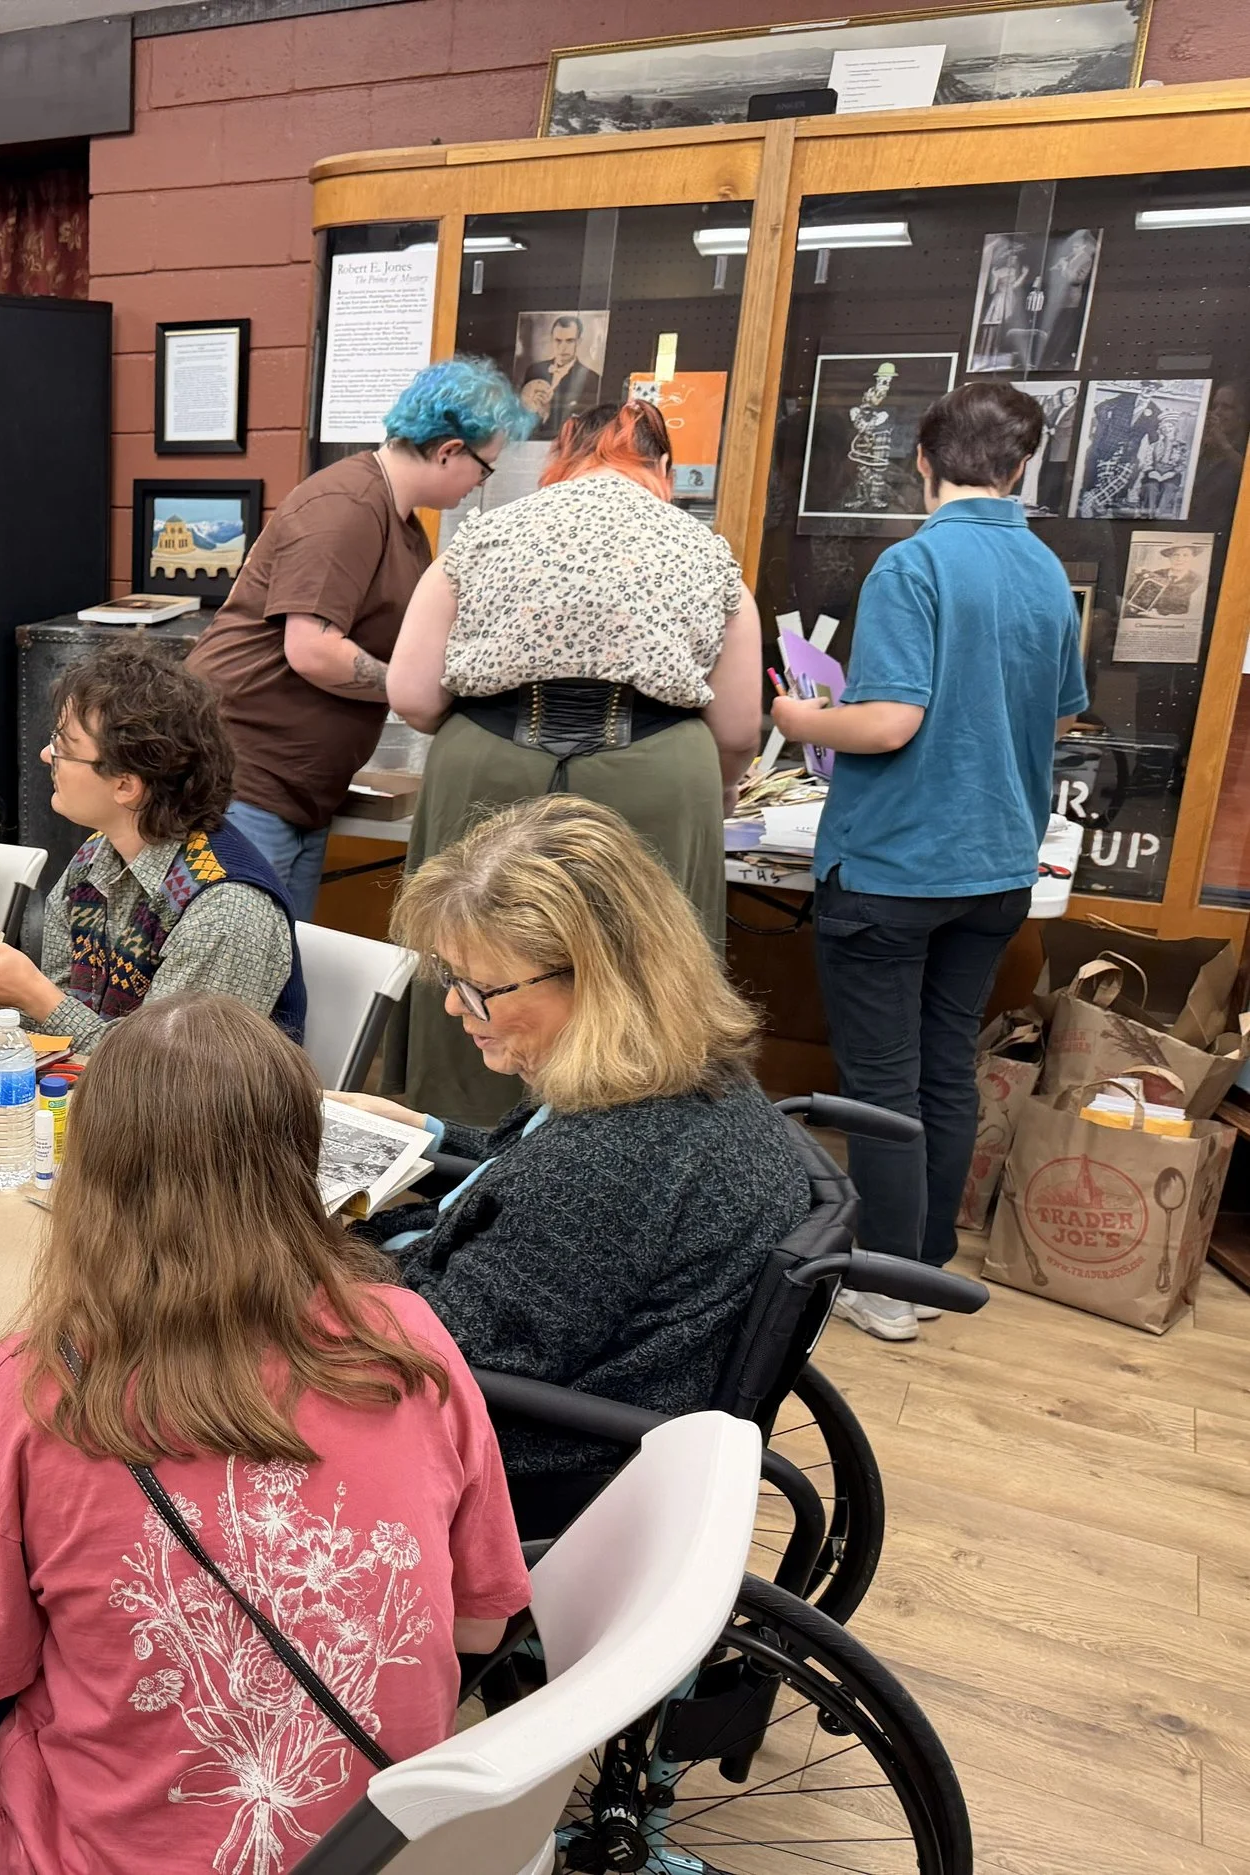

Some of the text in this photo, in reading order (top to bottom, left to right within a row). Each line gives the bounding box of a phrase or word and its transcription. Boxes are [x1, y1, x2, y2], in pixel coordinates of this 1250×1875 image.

[337, 261, 413, 276] Robert E. Jones
[355, 276, 367, 285] The
[390, 274, 398, 284] of
[1090, 830, 1161, 869] UP
[1035, 1207, 1135, 1230] TRADER
[1052, 1228, 1121, 1248] JOE'S
